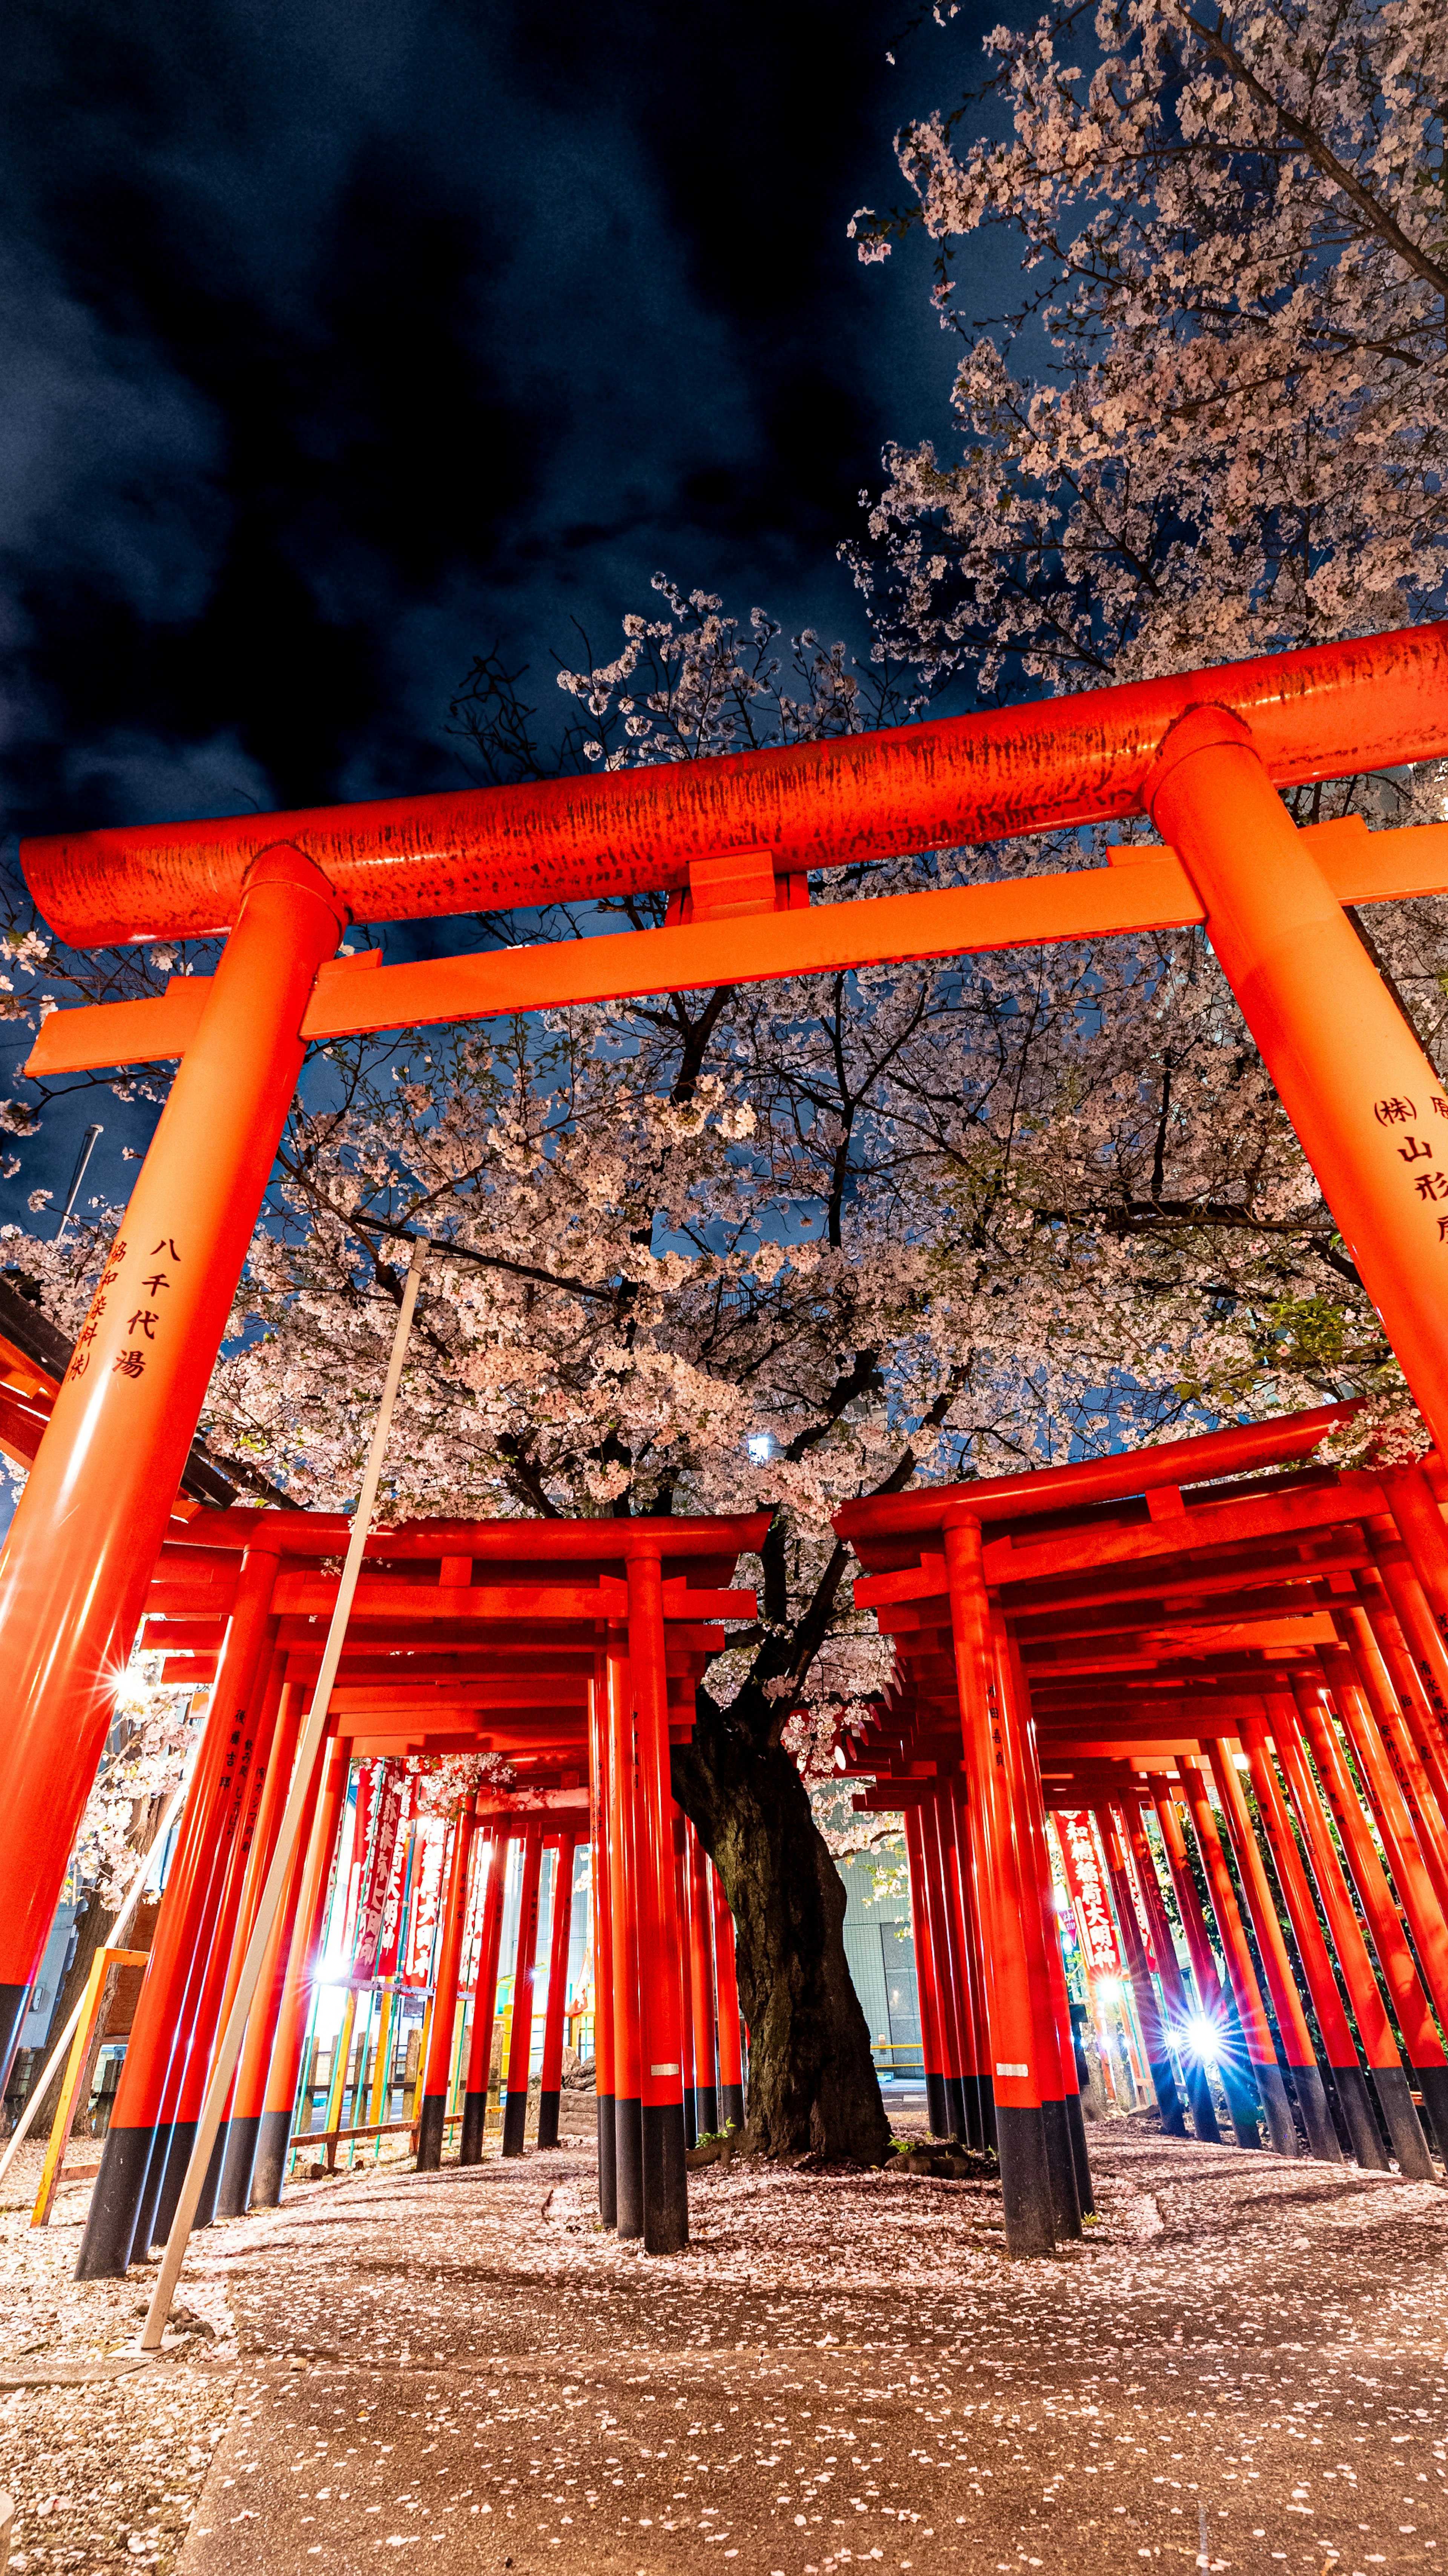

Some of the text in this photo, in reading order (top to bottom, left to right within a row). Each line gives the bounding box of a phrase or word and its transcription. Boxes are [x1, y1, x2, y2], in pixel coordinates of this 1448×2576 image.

[112, 1239, 181, 1379] 八千代湯
[1066, 1821, 1116, 1969] 和徳稲荷大明神
